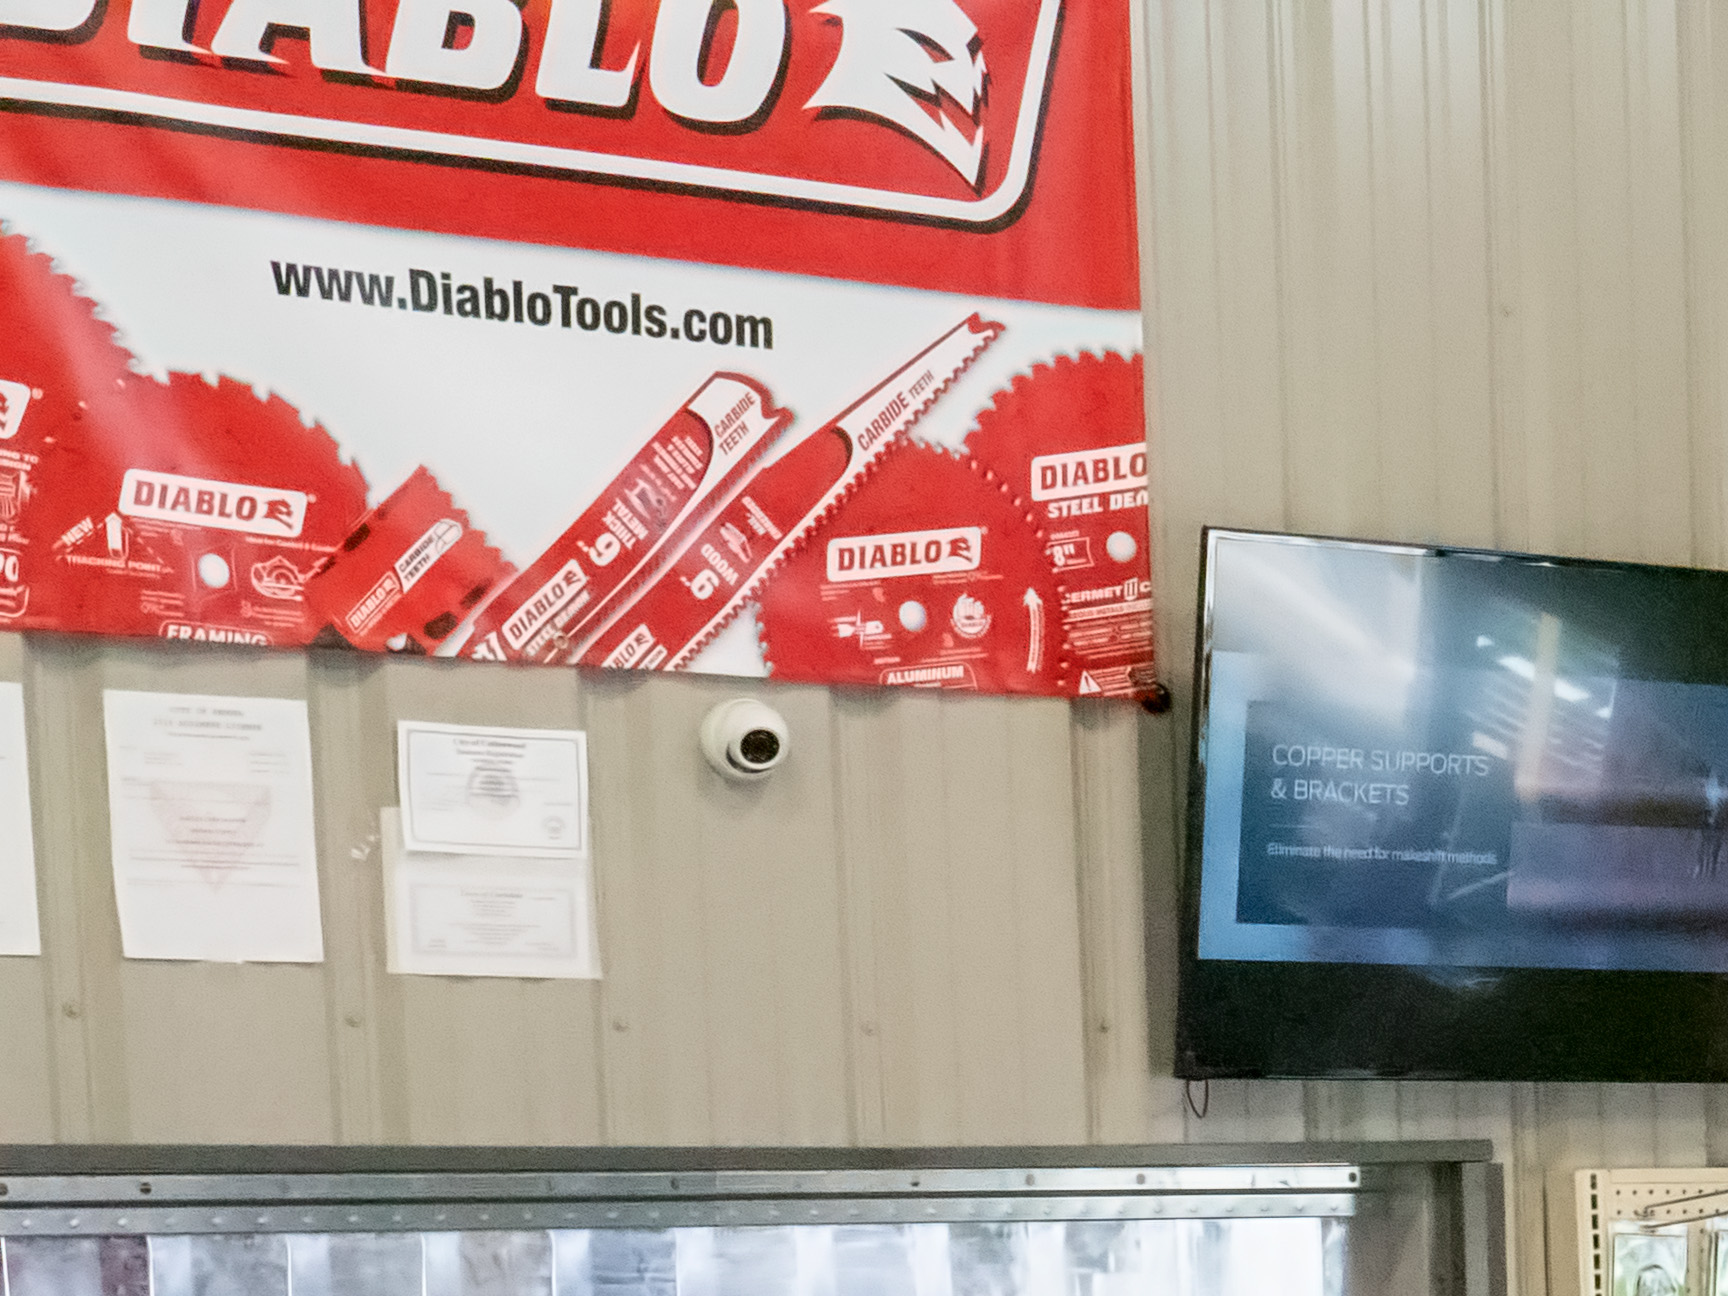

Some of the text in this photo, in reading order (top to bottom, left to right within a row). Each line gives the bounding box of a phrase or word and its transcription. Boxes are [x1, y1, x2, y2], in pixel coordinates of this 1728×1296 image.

[271, 260, 773, 350] www.DiabloTools.com
[714, 391, 756, 439] CARBIDE
[858, 370, 935, 450] CARBIDE TEETH
[719, 422, 749, 456] TEETH
[1040, 451, 1147, 491] DIABLO
[133, 480, 259, 522] DIABLO
[1047, 492, 1105, 519] STEEL
[60, 516, 94, 547] NEW
[600, 510, 640, 550] THICK
[610, 499, 652, 541] METAL
[66, 555, 125, 570] TRACKING
[398, 536, 435, 572] CARBIDE
[402, 555, 432, 584] TEETH
[698, 542, 741, 585] WOOD
[838, 539, 943, 572] DIABLO
[349, 587, 389, 629] DIABLO
[508, 586, 565, 639] DIABLO
[166, 623, 270, 646] FRAMING
[886, 665, 965, 685] ALUMINUM
[1272, 744, 1489, 776] COPPER SUPPORTS
[1270, 778, 1410, 806] & BRACKETS
[1267, 842, 1498, 866] Eliminate the need for makeshift methods
